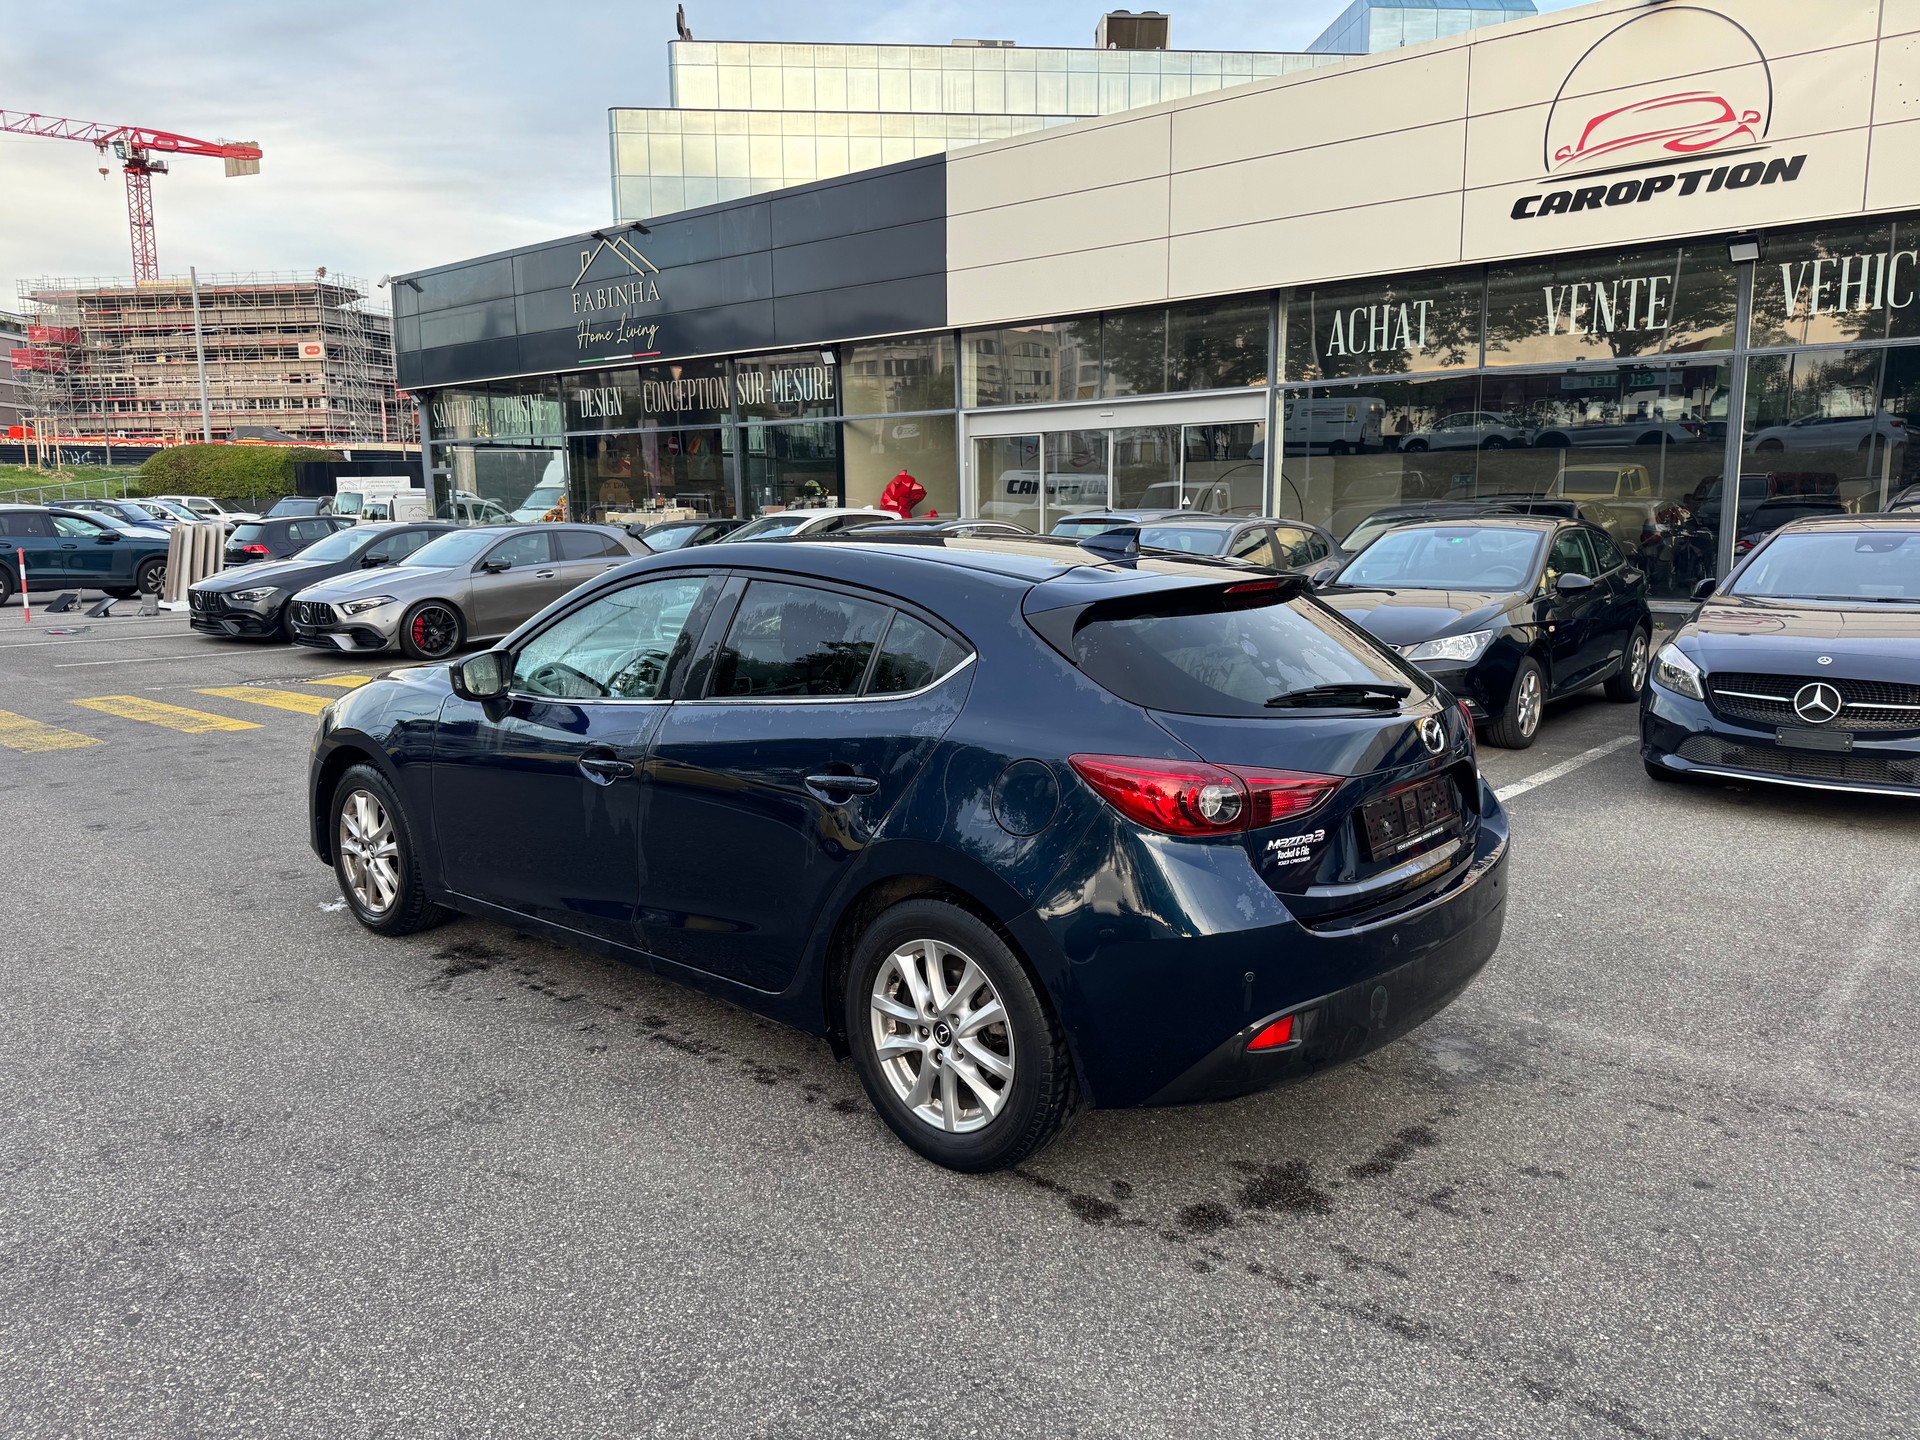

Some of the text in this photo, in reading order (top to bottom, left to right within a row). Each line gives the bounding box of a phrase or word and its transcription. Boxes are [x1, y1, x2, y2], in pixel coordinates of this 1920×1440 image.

[1510, 154, 1808, 221] CAROPTION
[572, 280, 661, 314] FABINHA
[1325, 249, 1920, 357] ACHAT VENTE VEHIC
[577, 312, 660, 350] Home Living
[432, 399, 482, 429] SANITAIRE
[503, 393, 546, 424] CUISINE
[579, 386, 623, 418] DESIGN
[643, 376, 730, 414] CONCEPTION
[736, 366, 834, 406] SUR-MESURE
